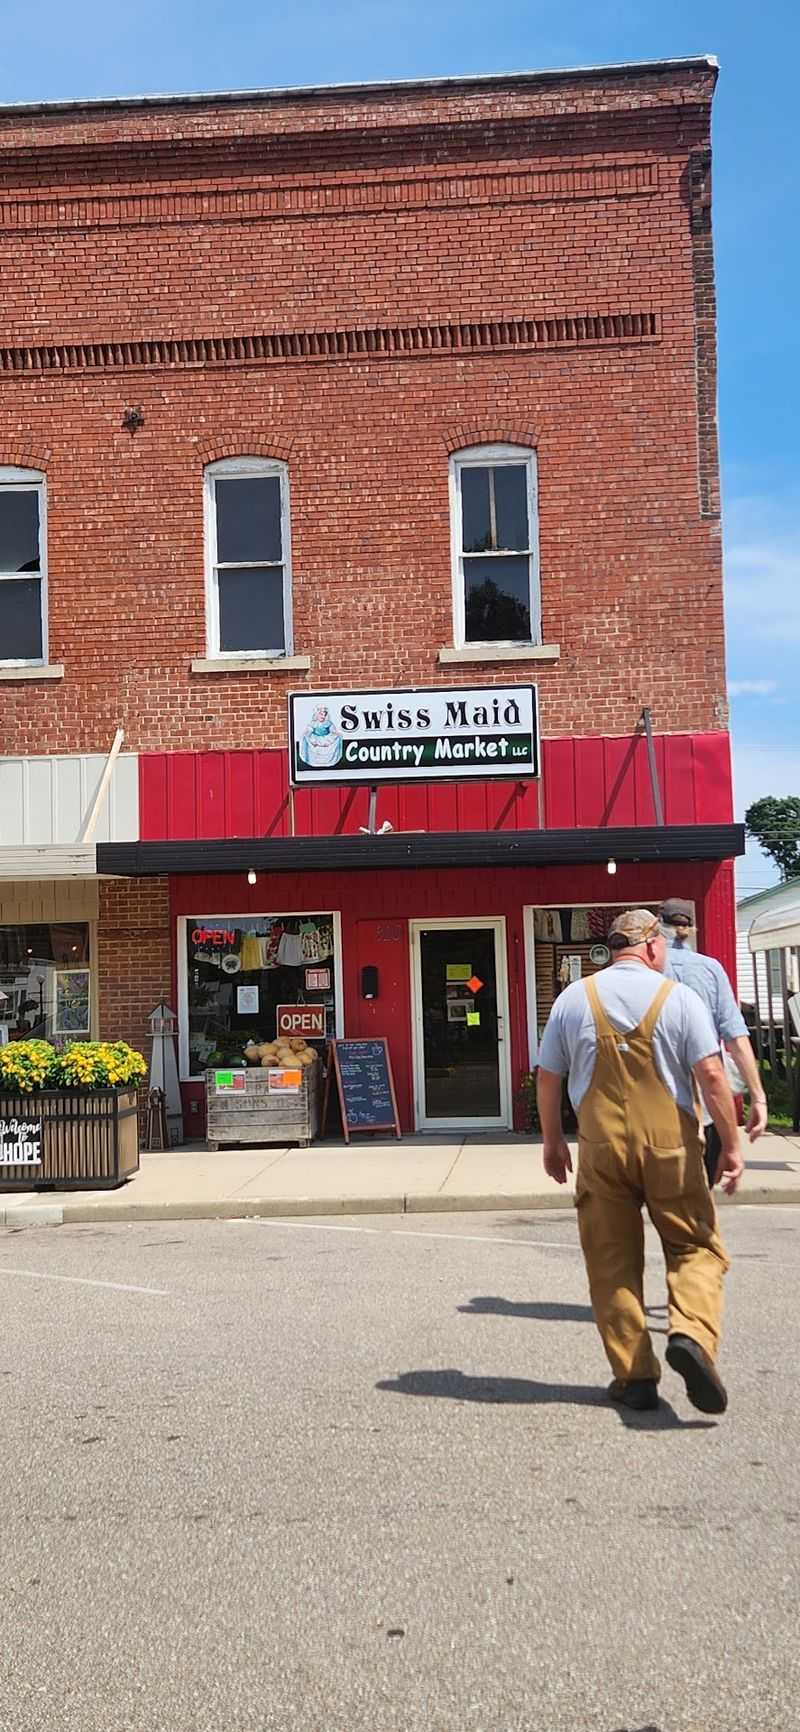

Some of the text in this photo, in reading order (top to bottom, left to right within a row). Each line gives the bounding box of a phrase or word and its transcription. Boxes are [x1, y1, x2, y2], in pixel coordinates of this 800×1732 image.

[340, 699, 521, 731] Swiss Maid
[345, 736, 528, 766] Country Market LLC
[191, 928, 236, 945] OPEN
[280, 1013, 323, 1031] OPEN
[3, 1141, 41, 1162] HOPE
